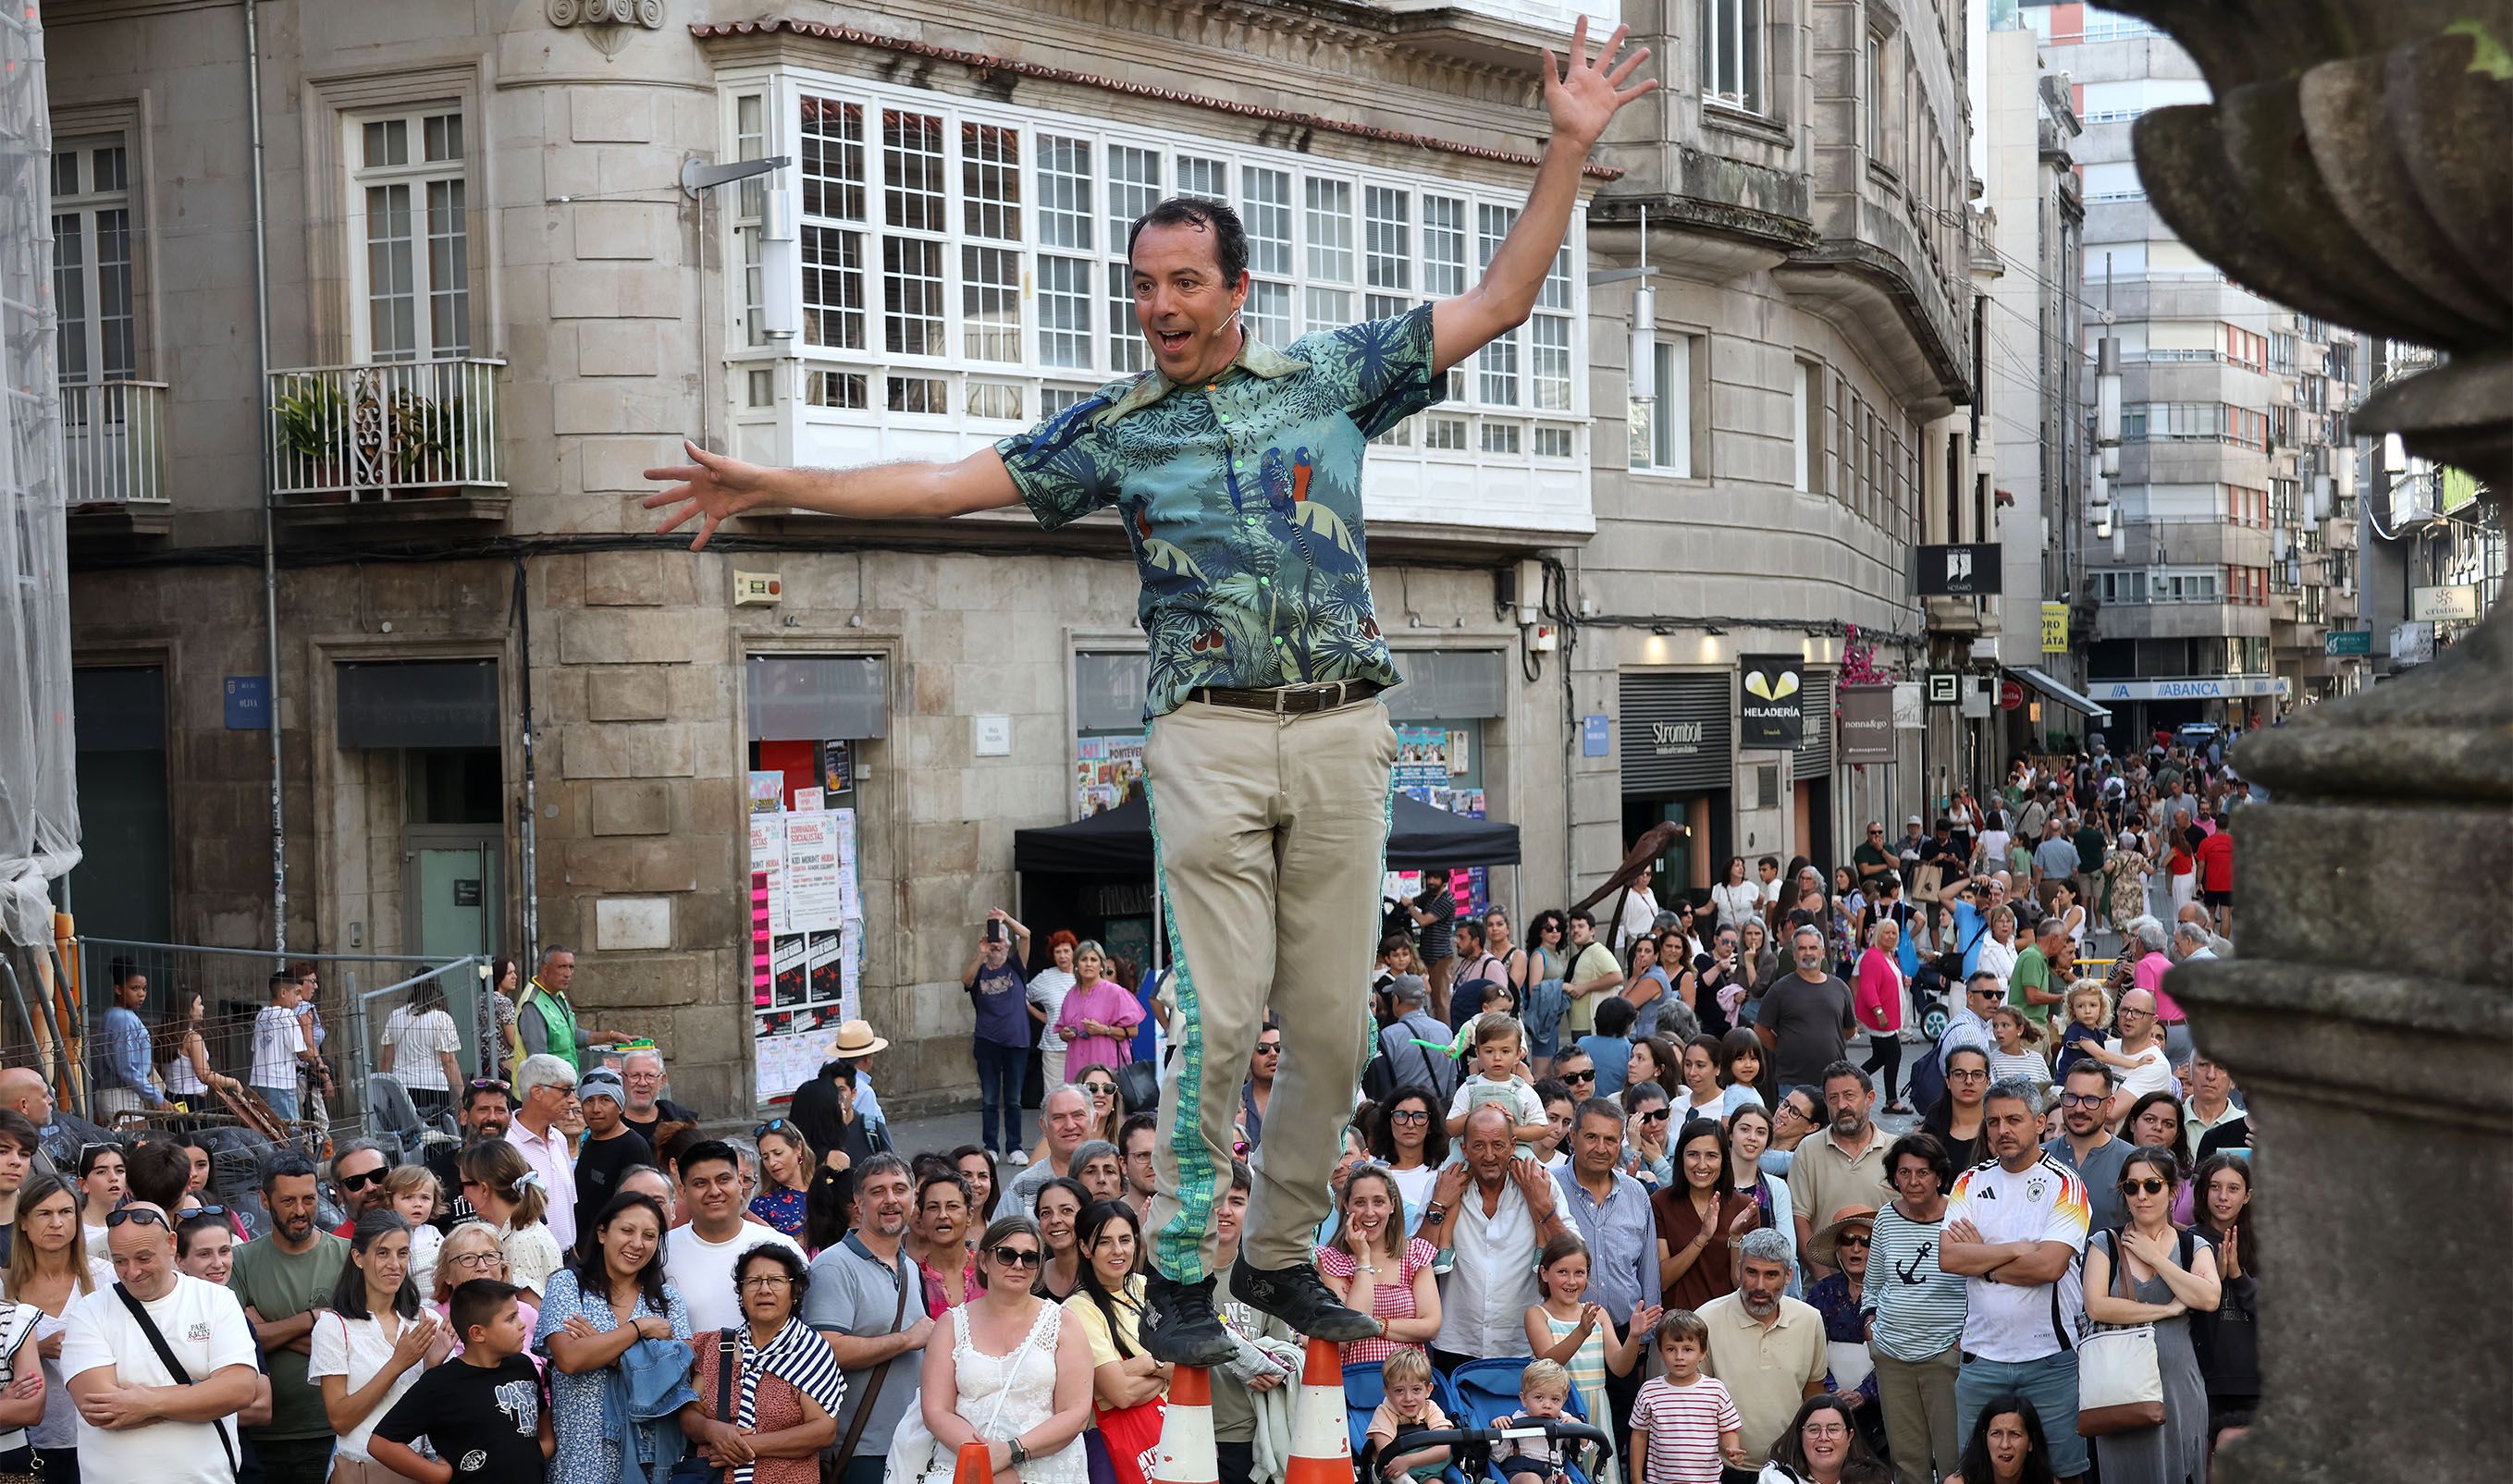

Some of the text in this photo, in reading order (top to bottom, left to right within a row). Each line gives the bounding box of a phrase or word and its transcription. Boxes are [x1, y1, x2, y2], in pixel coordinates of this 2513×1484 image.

[2425, 607, 2465, 616] cristina
[1744, 705, 1801, 717] HELADERÍA
[1844, 719, 1888, 730] nonna&go
